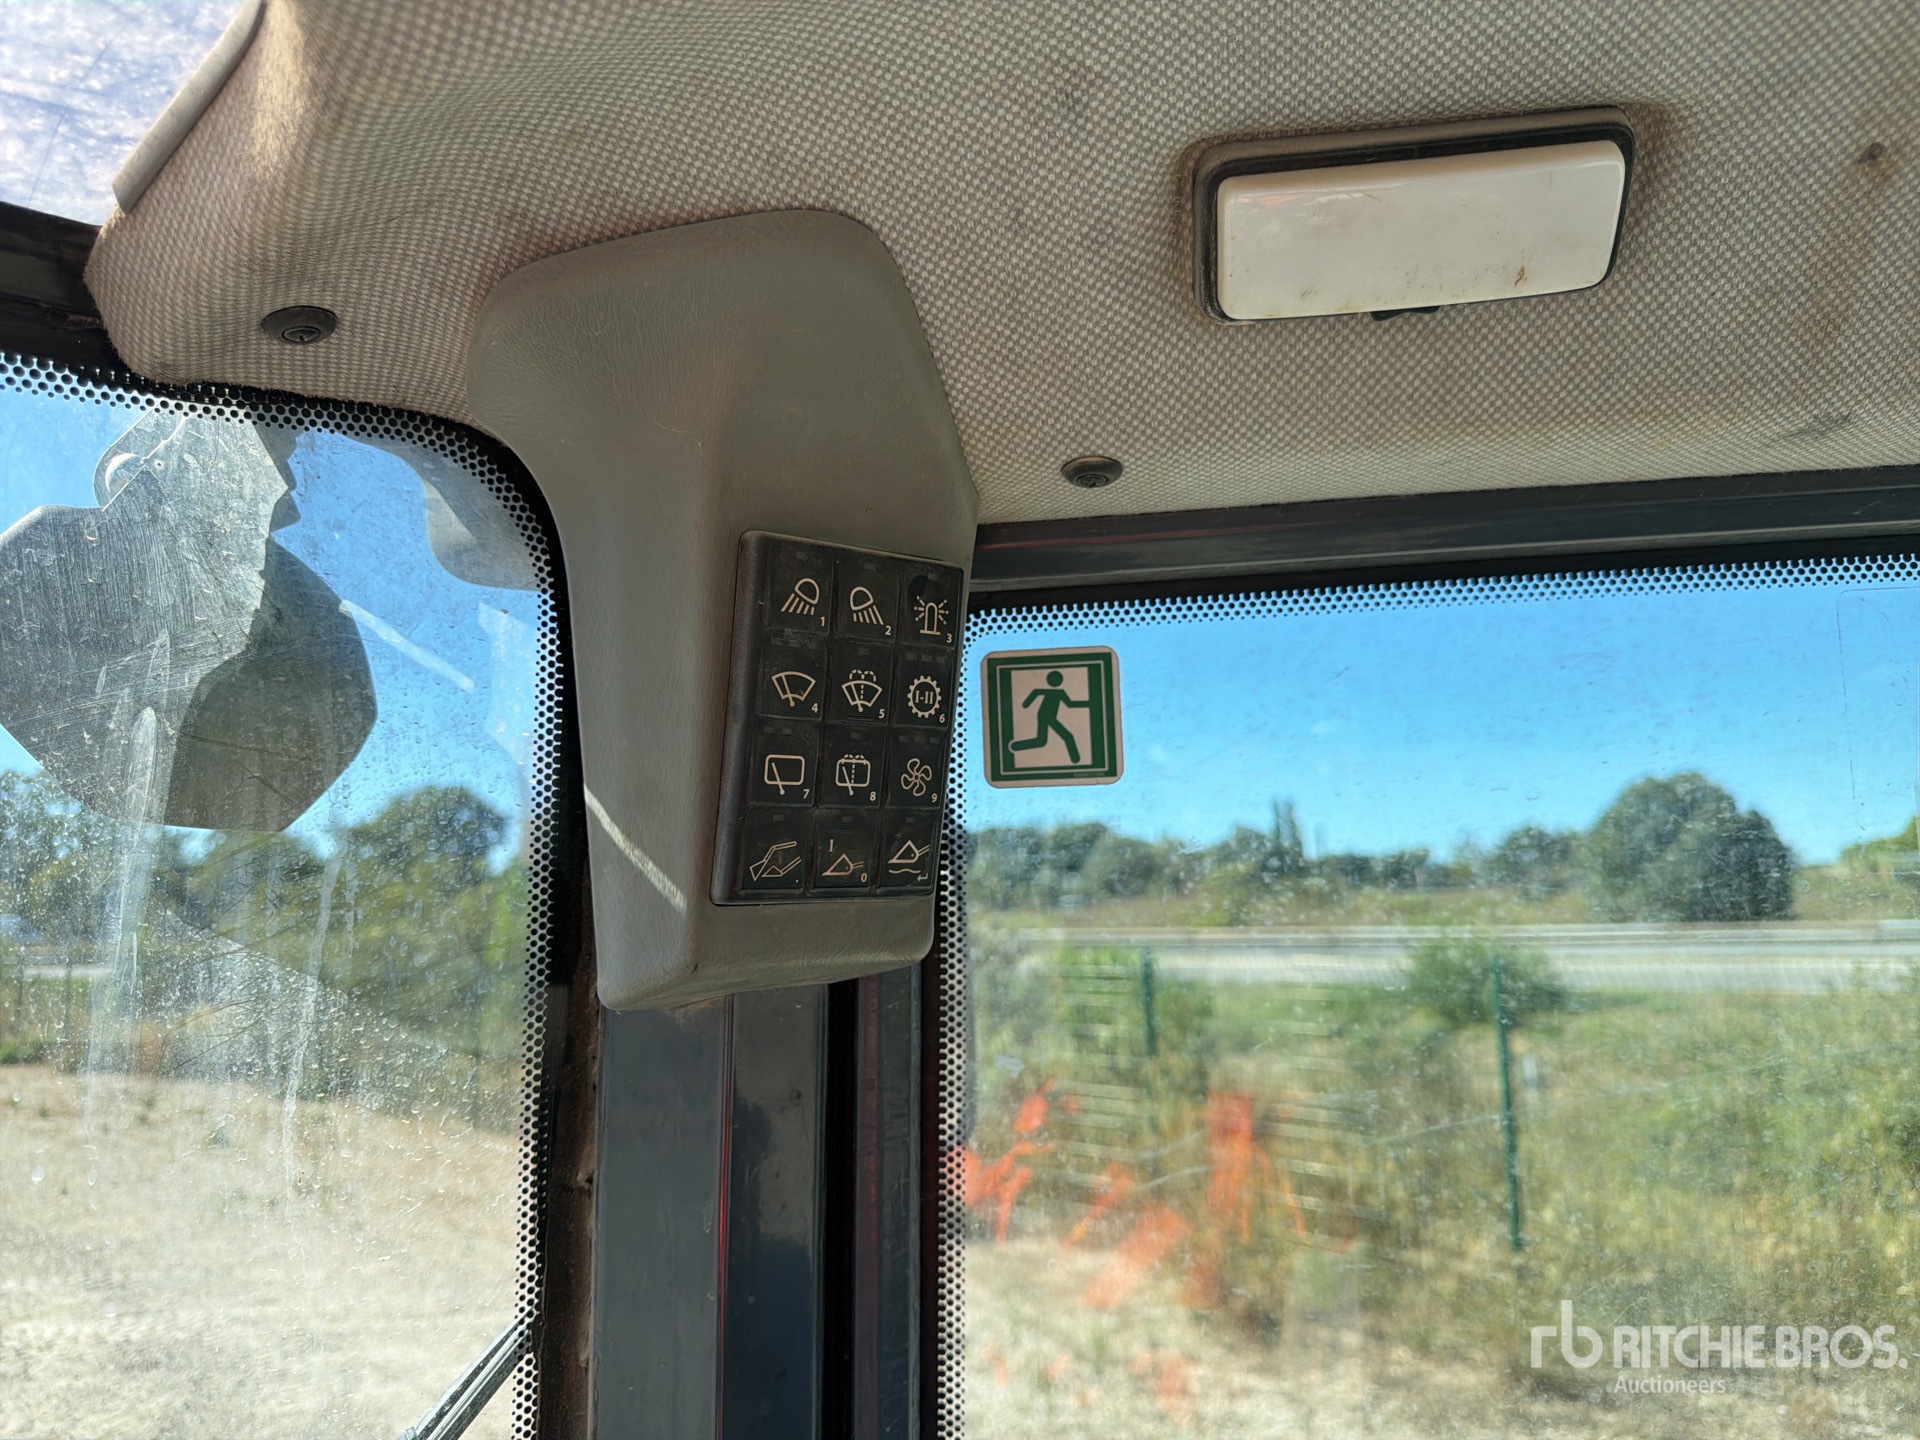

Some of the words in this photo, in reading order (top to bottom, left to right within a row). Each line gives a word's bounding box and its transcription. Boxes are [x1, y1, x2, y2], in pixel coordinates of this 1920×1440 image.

[820, 616, 825, 627] 1
[885, 625, 892, 636] 2
[946, 633, 953, 643] 3
[811, 702, 818, 713] 4
[878, 709, 885, 719] 5
[939, 714, 945, 723] 6
[803, 788, 810, 799] 7
[869, 791, 876, 801] 8
[931, 793, 938, 803] 9
[860, 873, 867, 883] 0
